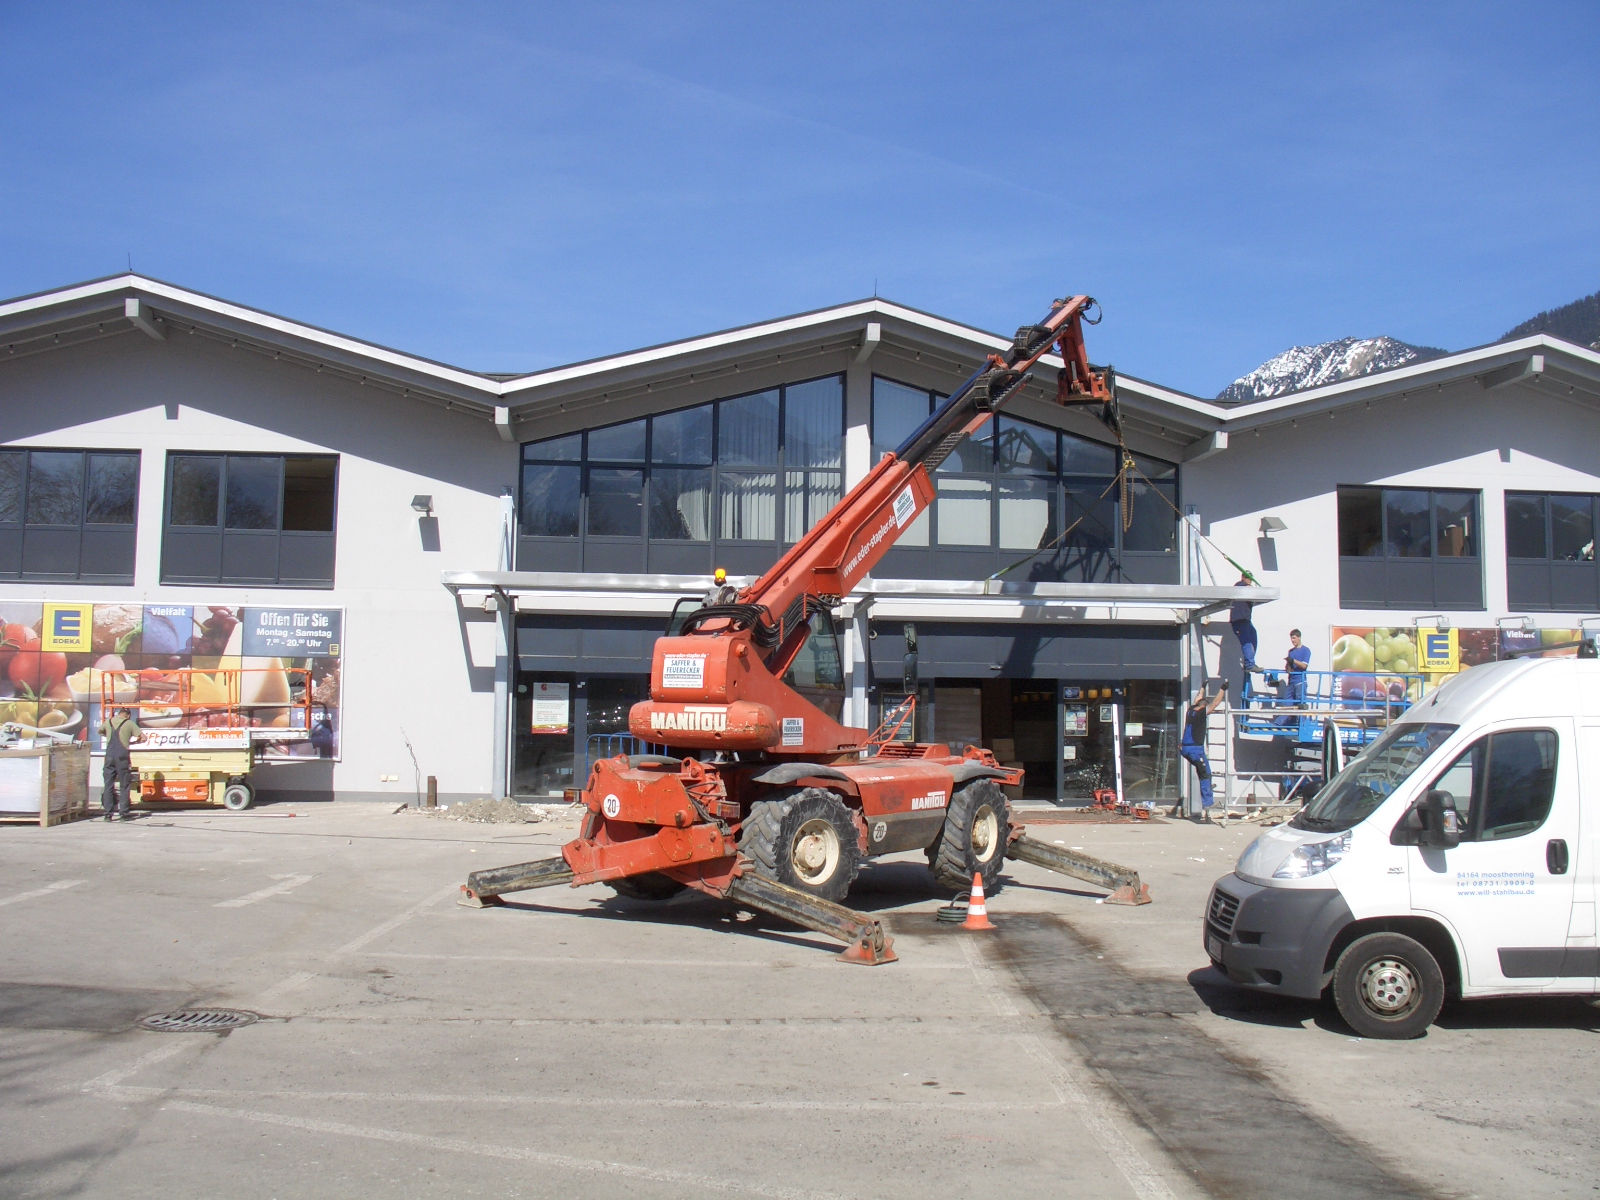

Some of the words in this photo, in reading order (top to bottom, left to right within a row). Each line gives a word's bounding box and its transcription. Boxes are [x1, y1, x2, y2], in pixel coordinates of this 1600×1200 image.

[842, 515, 896, 578] www.eder-stapler.de
[151, 607, 186, 616] Vielfalt
[54, 610, 81, 637] E
[260, 612, 290, 626] Offen
[293, 613, 309, 627] für
[311, 613, 329, 627] Sie
[256, 628, 288, 637] Montag
[295, 629, 332, 638] Samstag
[306, 639, 322, 647] Uhr
[1427, 635, 1449, 658] E
[651, 706, 727, 731] MANITOU
[608, 799, 616, 813] 20
[911, 791, 946, 810] MANITOU
[876, 825, 885, 839] 20
[1481, 871, 1534, 879] moosthenning
